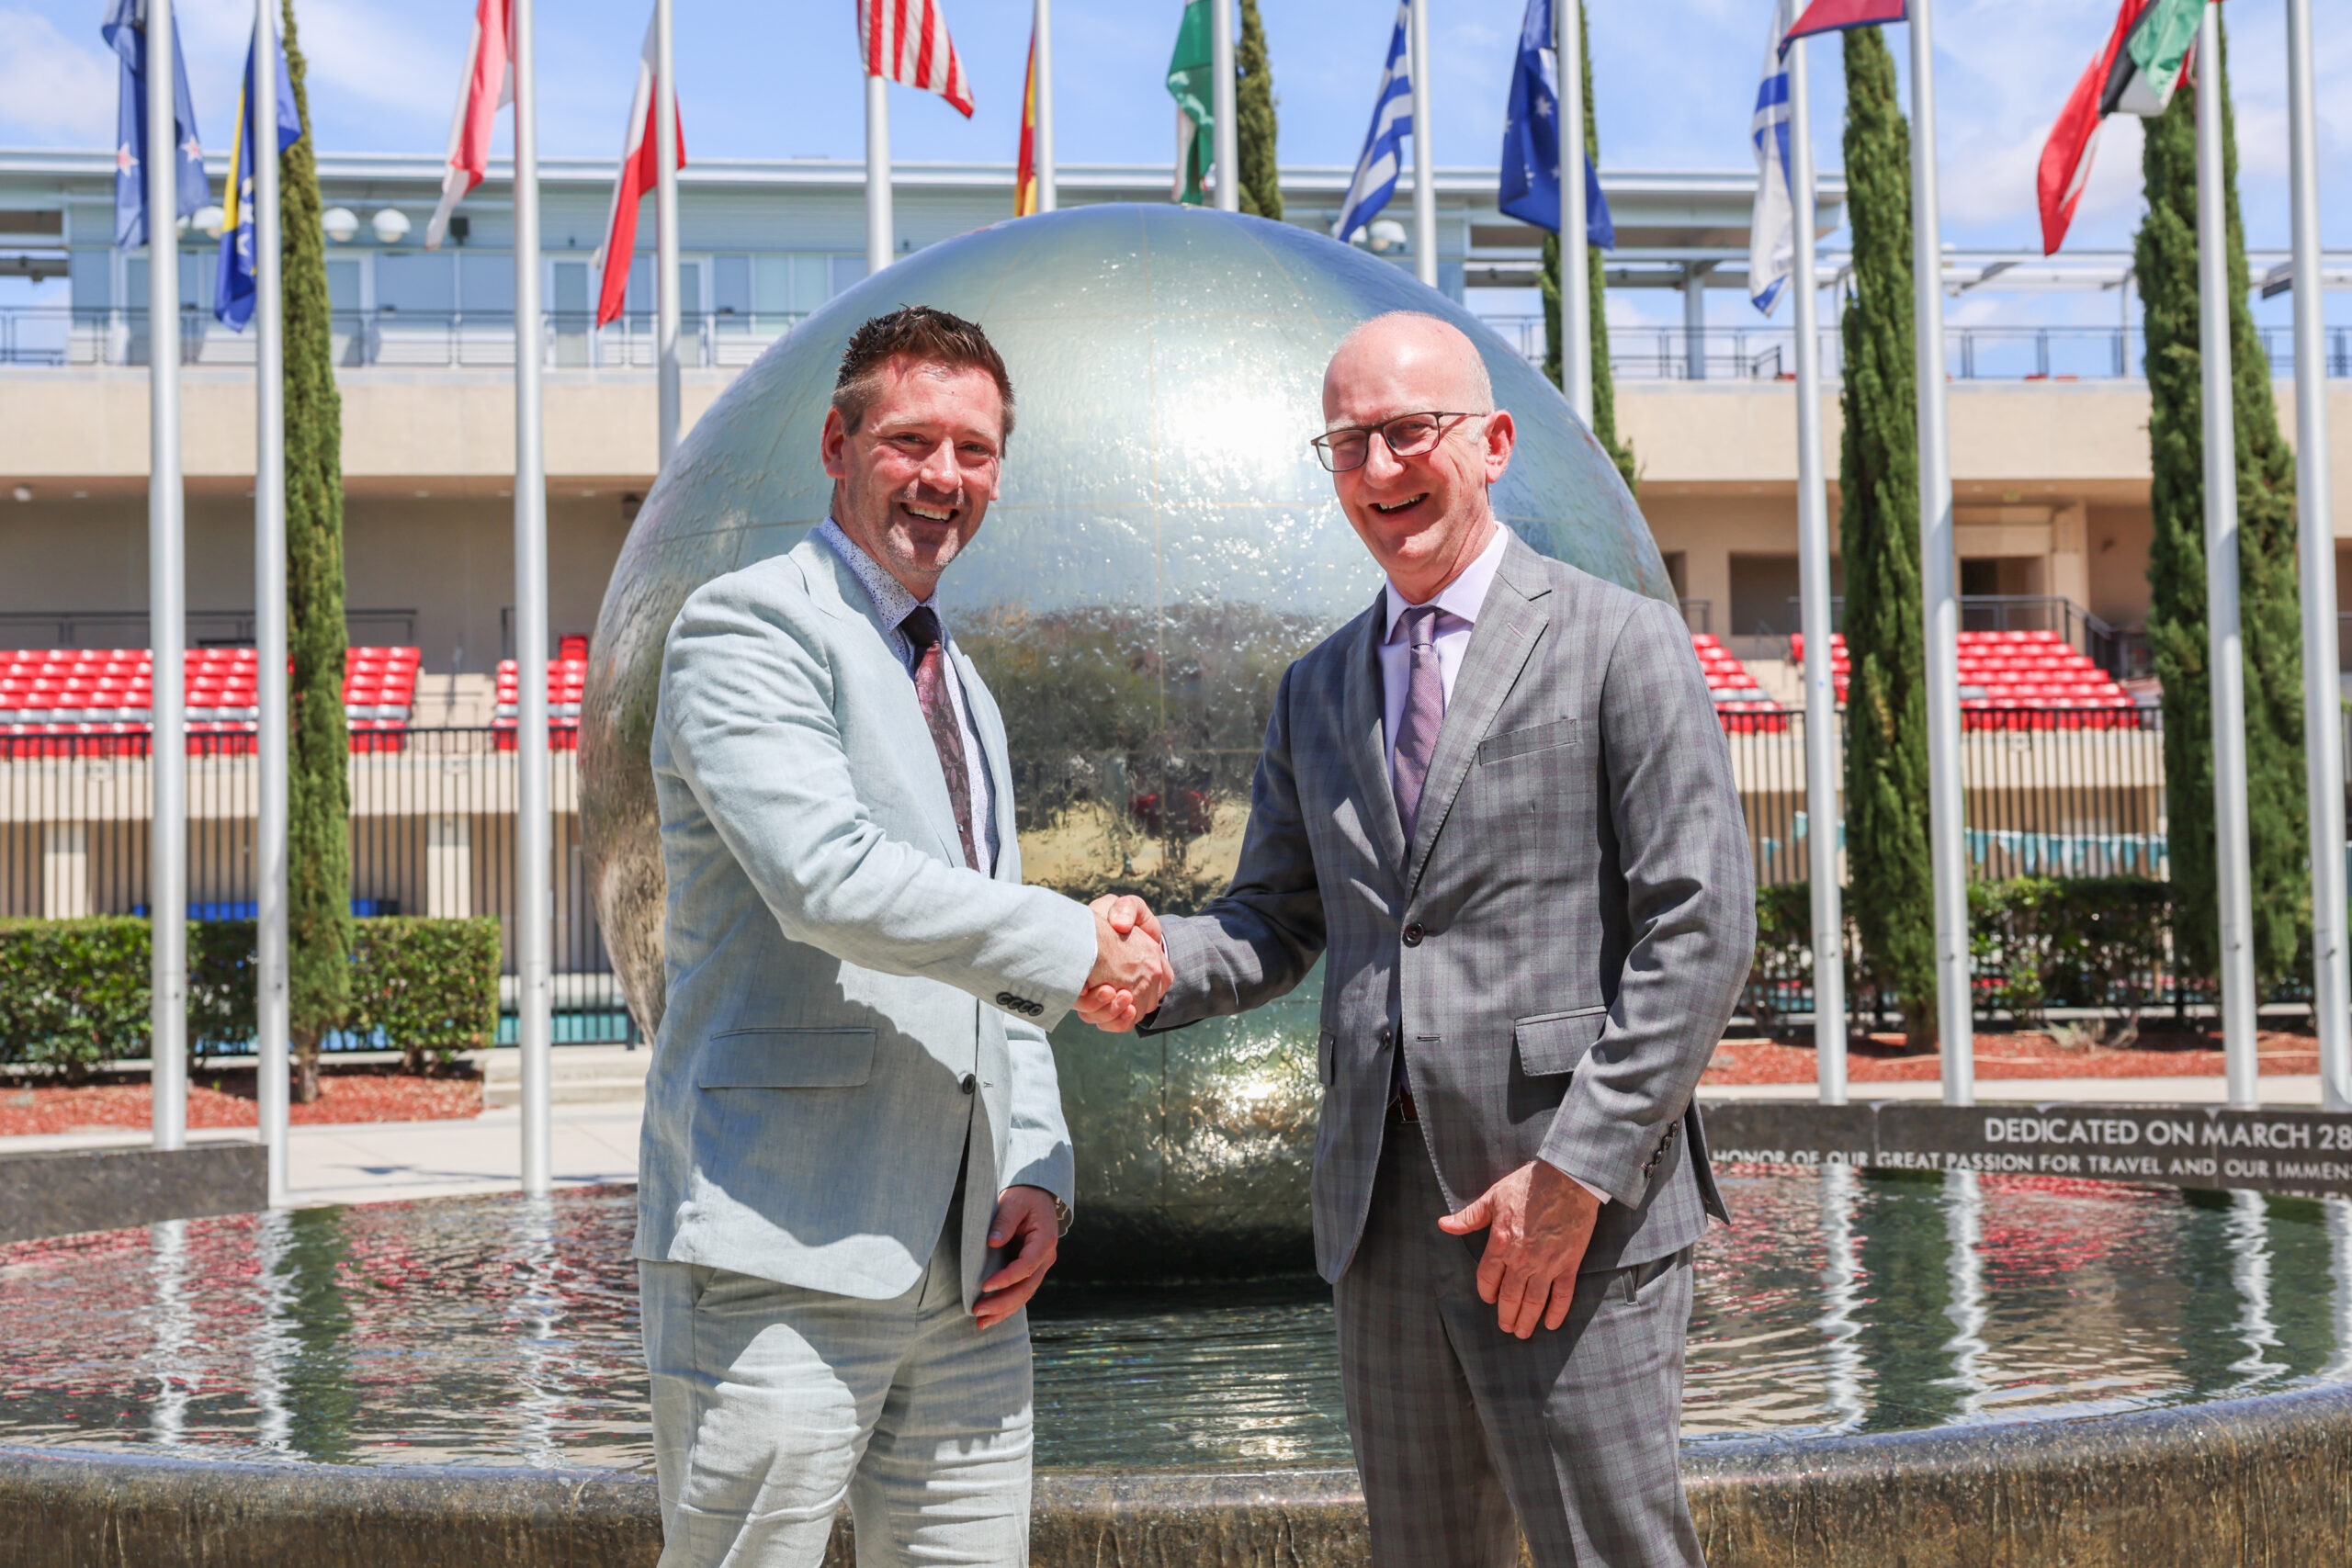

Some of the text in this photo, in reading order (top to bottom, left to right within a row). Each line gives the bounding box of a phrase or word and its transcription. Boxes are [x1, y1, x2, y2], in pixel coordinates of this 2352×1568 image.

[1984, 1117, 2352, 1150] DEDICATED ON MARCH 28
[1713, 1149, 2352, 1180] HONOR OF OUR GREAT PASSION FOR TRAVEL AND OUR IMMEN
